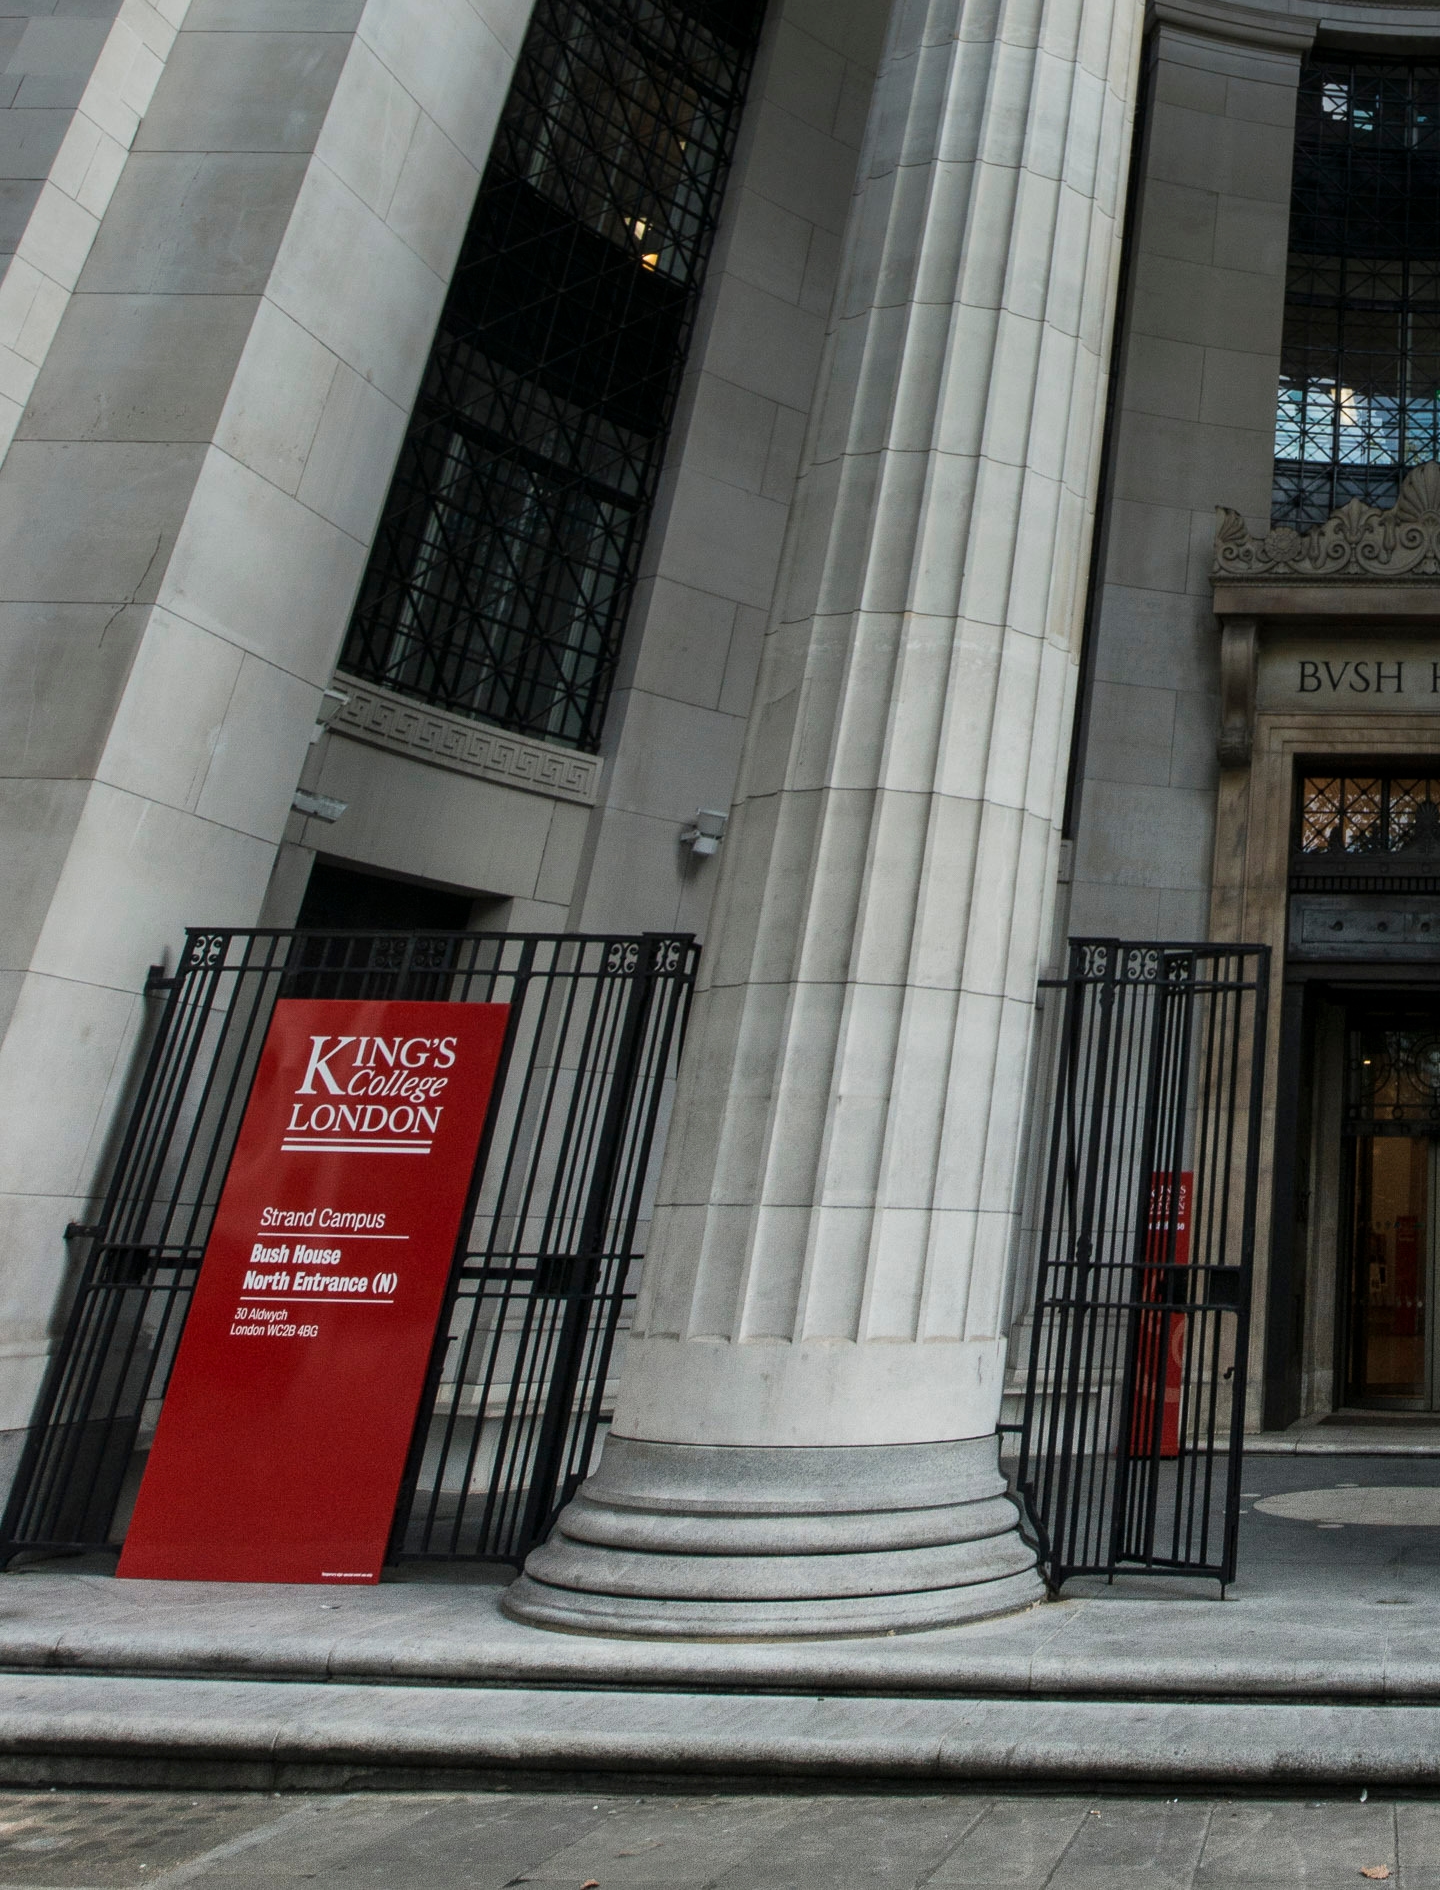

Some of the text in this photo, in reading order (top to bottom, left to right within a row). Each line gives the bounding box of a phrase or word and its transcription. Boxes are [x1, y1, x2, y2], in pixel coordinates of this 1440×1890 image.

[1298, 661, 1403, 693] BVSH
[294, 1035, 458, 1095] KING'S
[347, 1068, 449, 1103] College
[285, 1103, 444, 1134] LONDON
[260, 1206, 386, 1232] Strand Campus
[250, 1243, 342, 1265] Bush House
[242, 1270, 398, 1295] North Entrance (N)
[234, 1307, 288, 1323] 30 Aldwych
[229, 1323, 319, 1338] London WC2B 4BG
